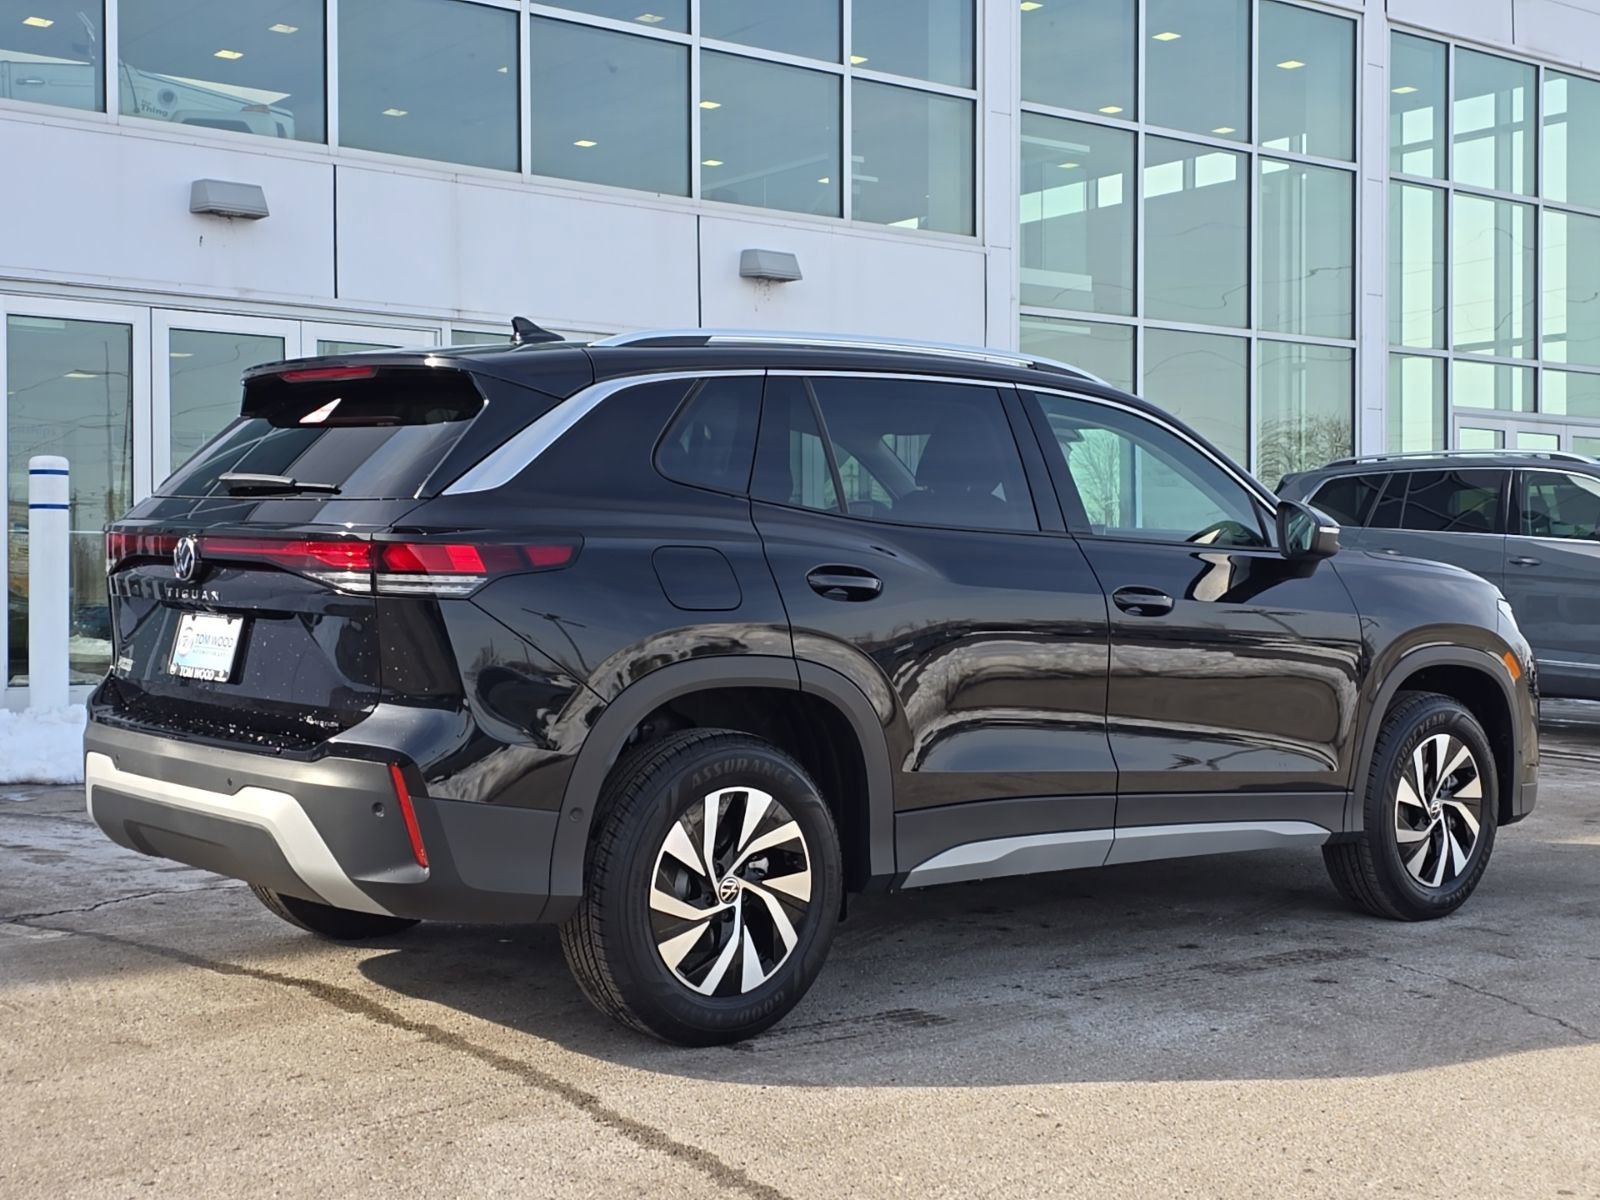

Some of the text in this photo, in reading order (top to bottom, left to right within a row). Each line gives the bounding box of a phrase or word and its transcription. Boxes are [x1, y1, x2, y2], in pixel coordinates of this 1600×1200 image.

[141, 104, 168, 117] Thing
[165, 587, 220, 601] TIGUAN
[195, 633, 211, 645] TOM
[211, 634, 234, 648] WOOD
[179, 666, 194, 678] TOM
[194, 668, 215, 681] WOOD
[1393, 713, 1447, 780] GOODYEAR
[691, 758, 797, 789] ASSURANCE
